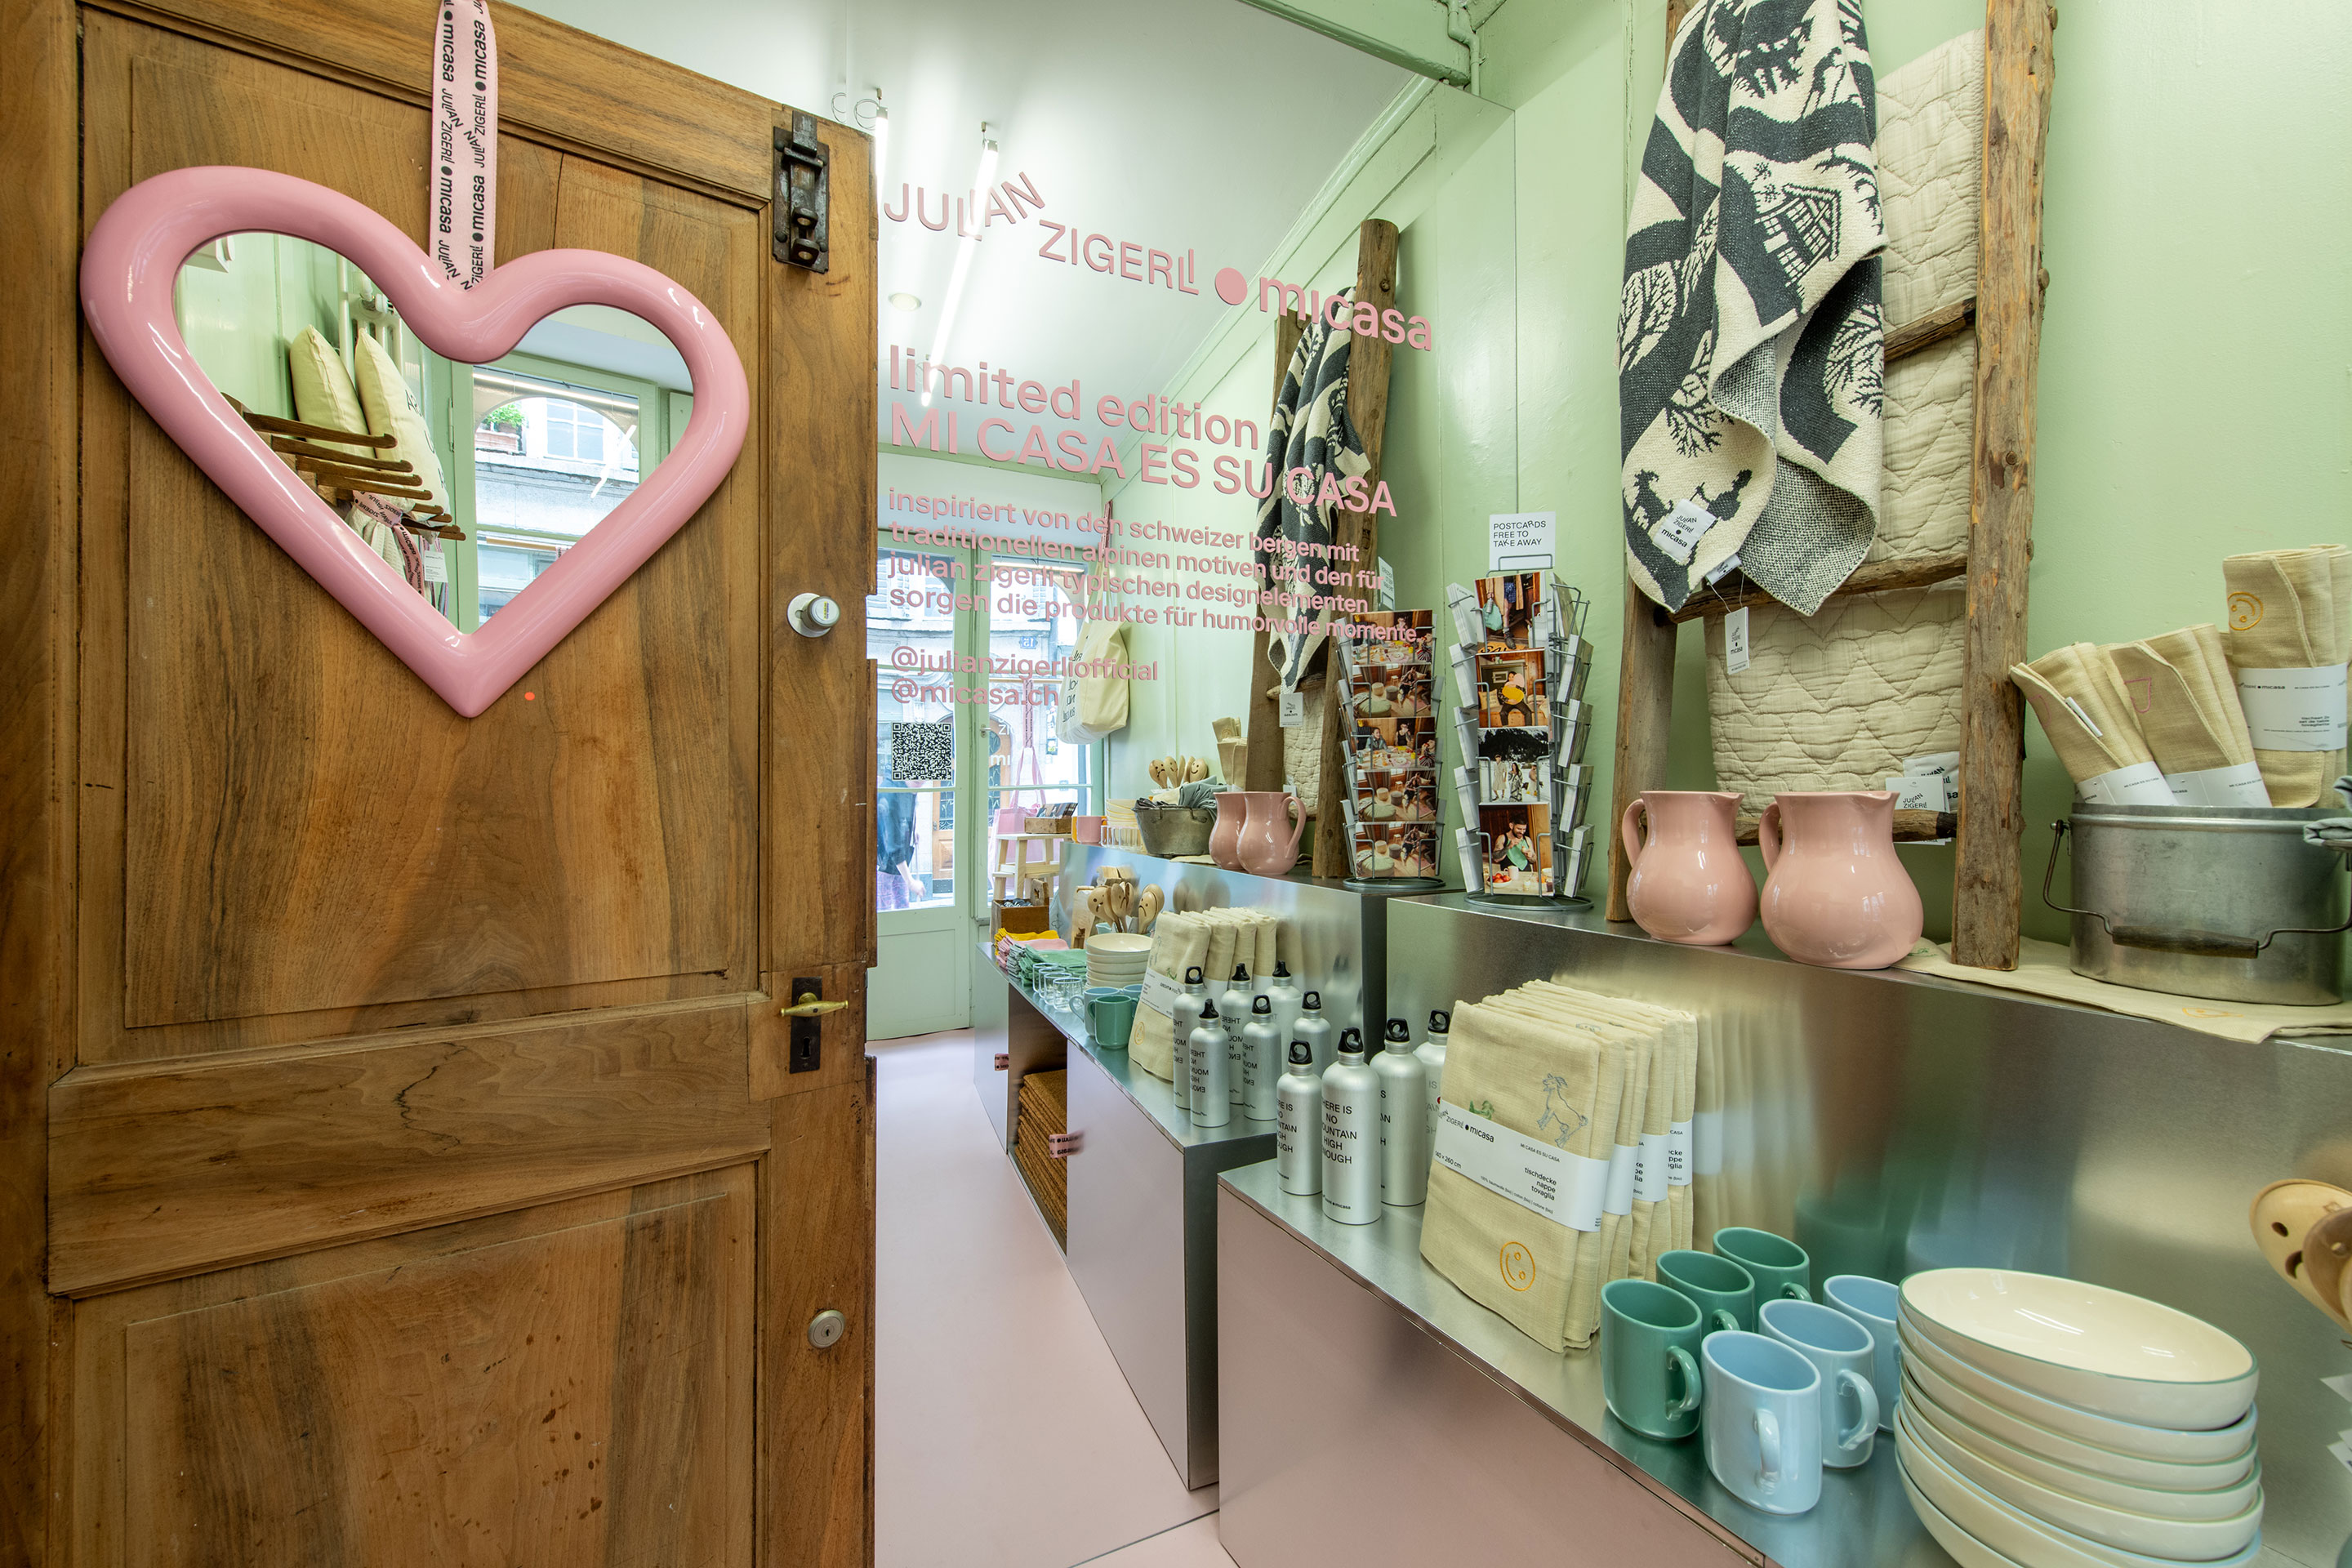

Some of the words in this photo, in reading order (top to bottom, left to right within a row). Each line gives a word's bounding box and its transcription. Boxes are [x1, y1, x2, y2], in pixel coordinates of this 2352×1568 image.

[443, 24, 454, 82] micasa
[474, 20, 488, 79] micasa
[439, 177, 452, 234] micasa
[472, 175, 485, 230] micasa
[883, 171, 1045, 242] JULIAN
[1259, 276, 1432, 352] micasa
[889, 345, 1081, 419] limited
[1096, 393, 1258, 451] edition
[891, 402, 958, 455] MI
[977, 417, 1126, 479] CASA
[1141, 443, 1200, 489] ES
[1213, 456, 1274, 499] SU
[1286, 470, 1397, 518] CASA
[889, 488, 1016, 523] inspiriert
[1022, 508, 1070, 529] von
[1076, 512, 1123, 536] den
[1129, 520, 1244, 549] schweizer
[1250, 532, 1321, 559] bergen
[1327, 543, 1359, 562] mit
[1494, 520, 1546, 530] POSTCARDS
[1494, 531, 1515, 539] FREE
[1661, 528, 1688, 548] micasa
[889, 521, 1076, 559] traditionellen
[1082, 542, 1169, 569] alpinen
[1177, 555, 1266, 578] motiven
[1272, 564, 1310, 582] und
[1316, 568, 1352, 586] den
[1356, 570, 1384, 590] für
[1494, 539, 1515, 547] TAKE
[1517, 538, 1542, 546] AWAY
[888, 552, 966, 580] julian
[974, 564, 1054, 588] zigerli
[1062, 571, 1180, 598] typischen
[1187, 580, 1368, 613] designelementen
[890, 587, 990, 615] sorgen
[997, 594, 1038, 616] die
[1045, 601, 1158, 624] produkte
[1164, 606, 1197, 626] für
[1203, 608, 1321, 636] humorvolle
[1325, 622, 1422, 643] momente.
[891, 645, 1158, 681] @julianzigerliofficial
[891, 678, 1059, 706] @micasa.ch
[1325, 1113, 1338, 1125] NO
[1343, 1106, 1352, 1114] IS
[1324, 1136, 1343, 1150] HIGH
[1470, 1126, 1494, 1143] micasa
[1525, 1167, 1557, 1186] tischdecke
[1537, 1181, 1556, 1193] nappe
[1531, 1186, 1555, 1200] tovaglia
